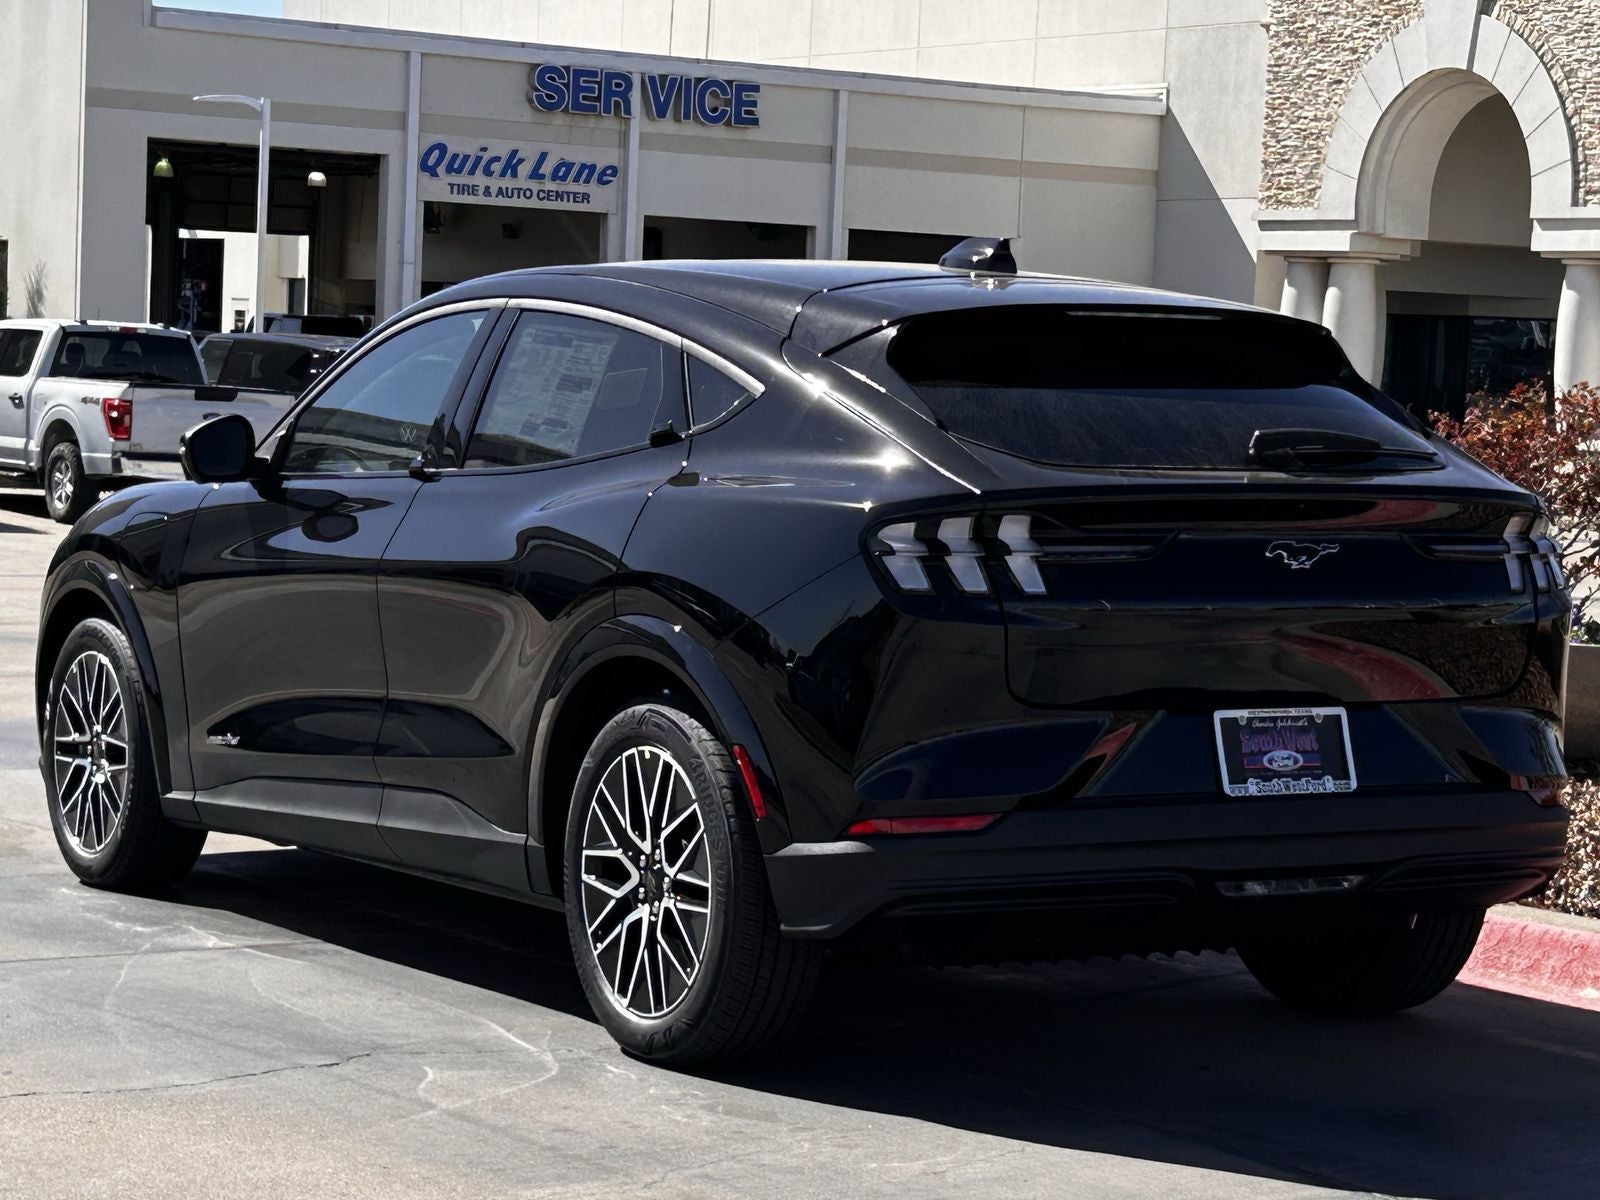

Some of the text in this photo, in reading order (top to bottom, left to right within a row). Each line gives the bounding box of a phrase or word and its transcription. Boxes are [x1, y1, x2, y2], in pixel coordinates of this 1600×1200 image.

[531, 64, 760, 128] SERVICE
[419, 142, 619, 187] Quick Lane
[448, 182, 591, 205] TIRE & AUTO CENTER
